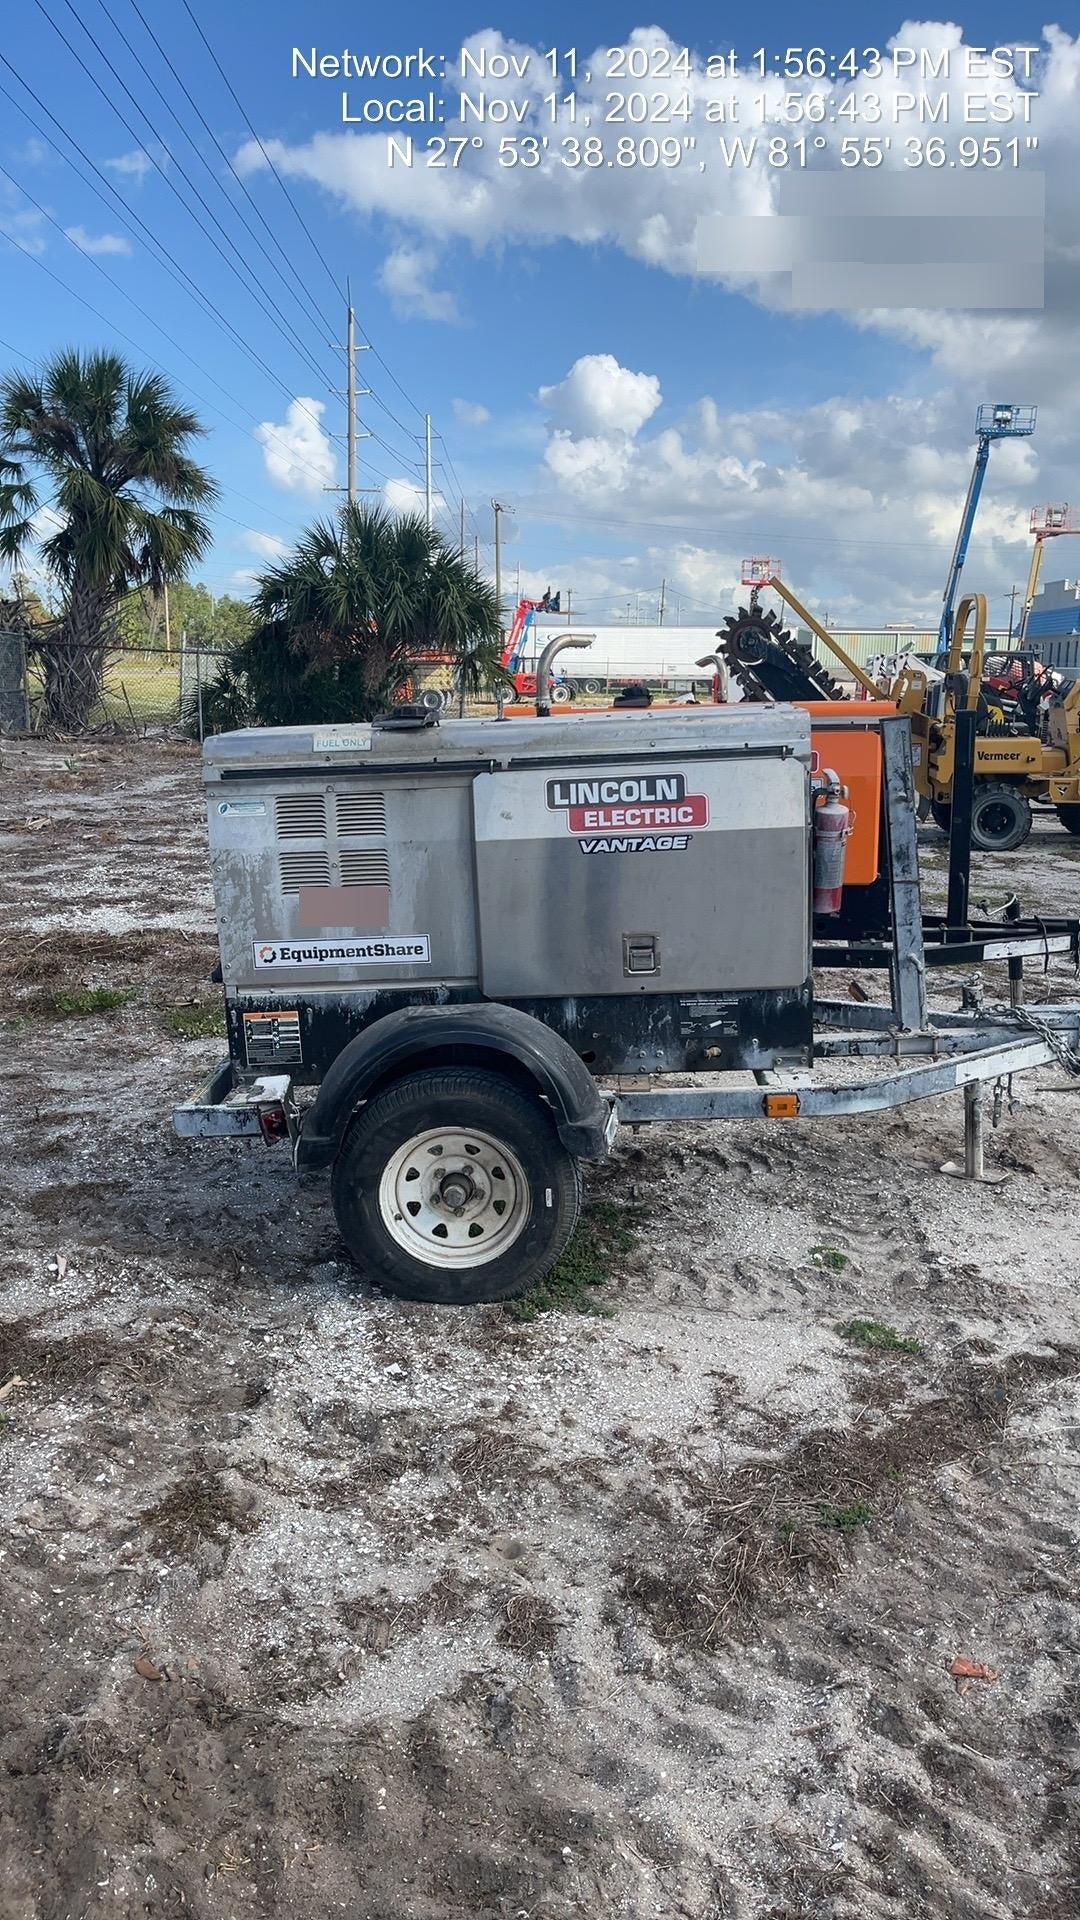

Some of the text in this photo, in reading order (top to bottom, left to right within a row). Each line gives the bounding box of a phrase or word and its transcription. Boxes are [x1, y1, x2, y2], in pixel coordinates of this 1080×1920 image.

[316, 738, 367, 747] FUEL ONLY
[977, 751, 1021, 761] Vermeer
[553, 778, 678, 806] LINCOLN
[584, 806, 694, 828] ELECTRIC
[579, 836, 690, 854] VANTAGE
[279, 944, 424, 963] EquipmentShare
